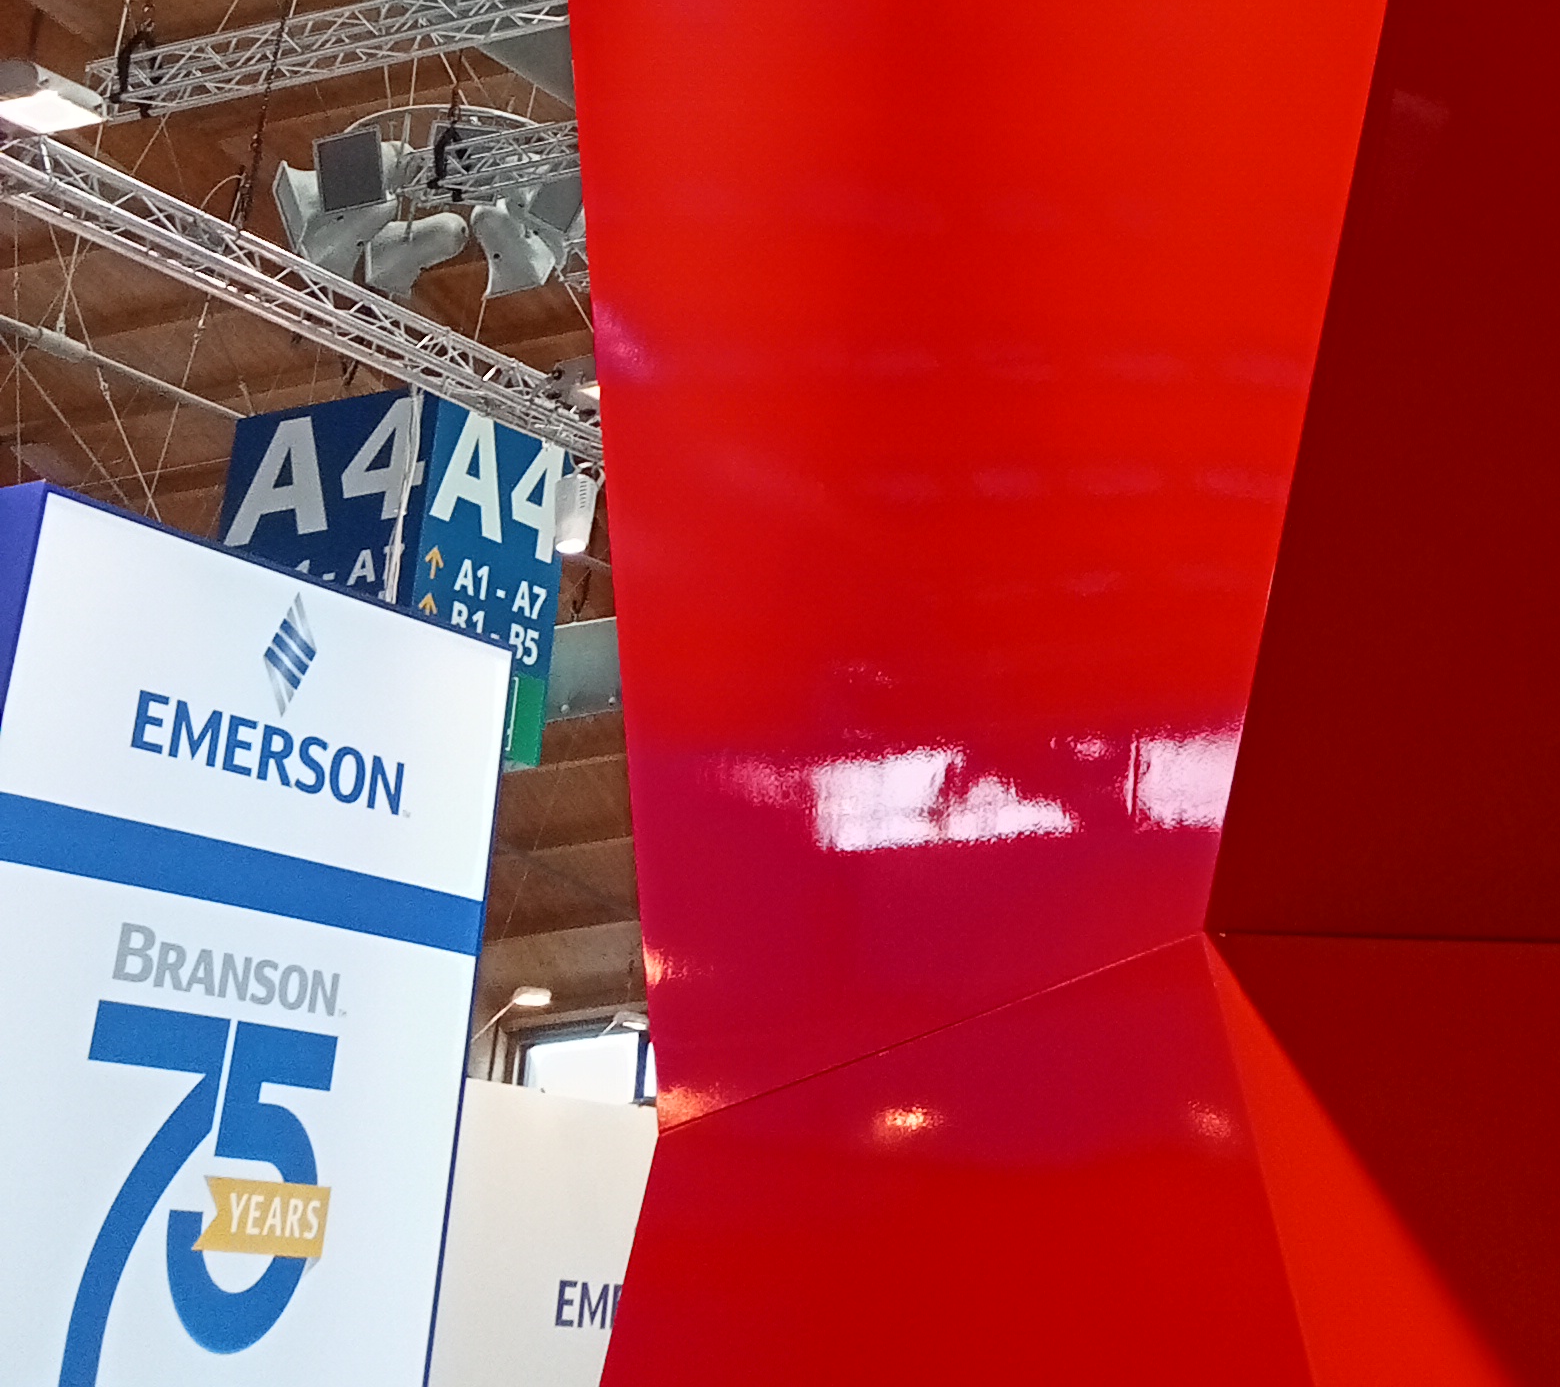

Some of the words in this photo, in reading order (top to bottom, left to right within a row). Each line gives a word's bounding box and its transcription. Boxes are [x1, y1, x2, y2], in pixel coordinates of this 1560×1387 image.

[223, 395, 426, 547] A4
[429, 411, 567, 564] A4
[453, 558, 490, 601] A1
[511, 580, 548, 620] A7
[508, 622, 540, 666] B5
[130, 689, 406, 816] EMERSON
[111, 922, 341, 1017] BRANSON
[58, 999, 339, 1387] 75
[228, 1192, 321, 1240] YEARS
